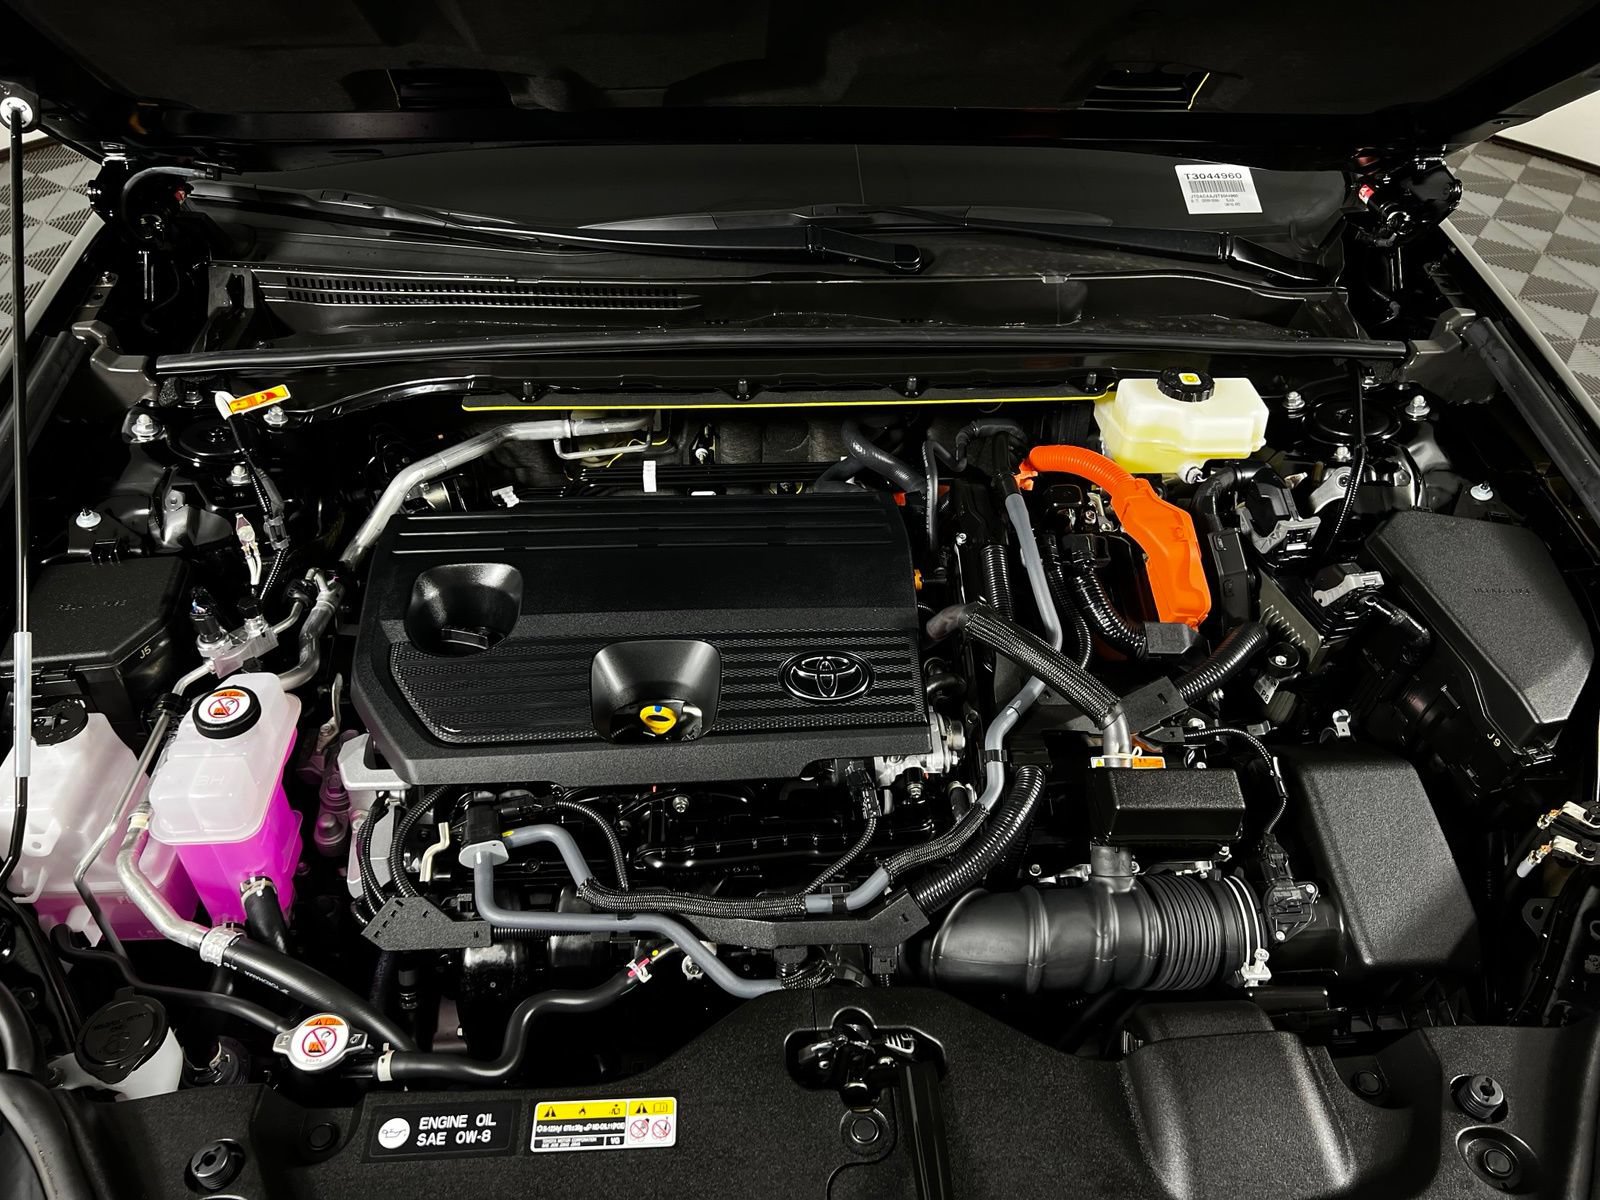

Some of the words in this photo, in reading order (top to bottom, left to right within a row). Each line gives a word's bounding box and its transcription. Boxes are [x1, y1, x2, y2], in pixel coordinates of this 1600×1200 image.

[1184, 172, 1242, 180] T3044960
[140, 645, 152, 659] J5
[1487, 733, 1501, 746] J9
[419, 1115, 468, 1130] ENGINE
[476, 1113, 496, 1127] OIL
[416, 1132, 447, 1147] SAE
